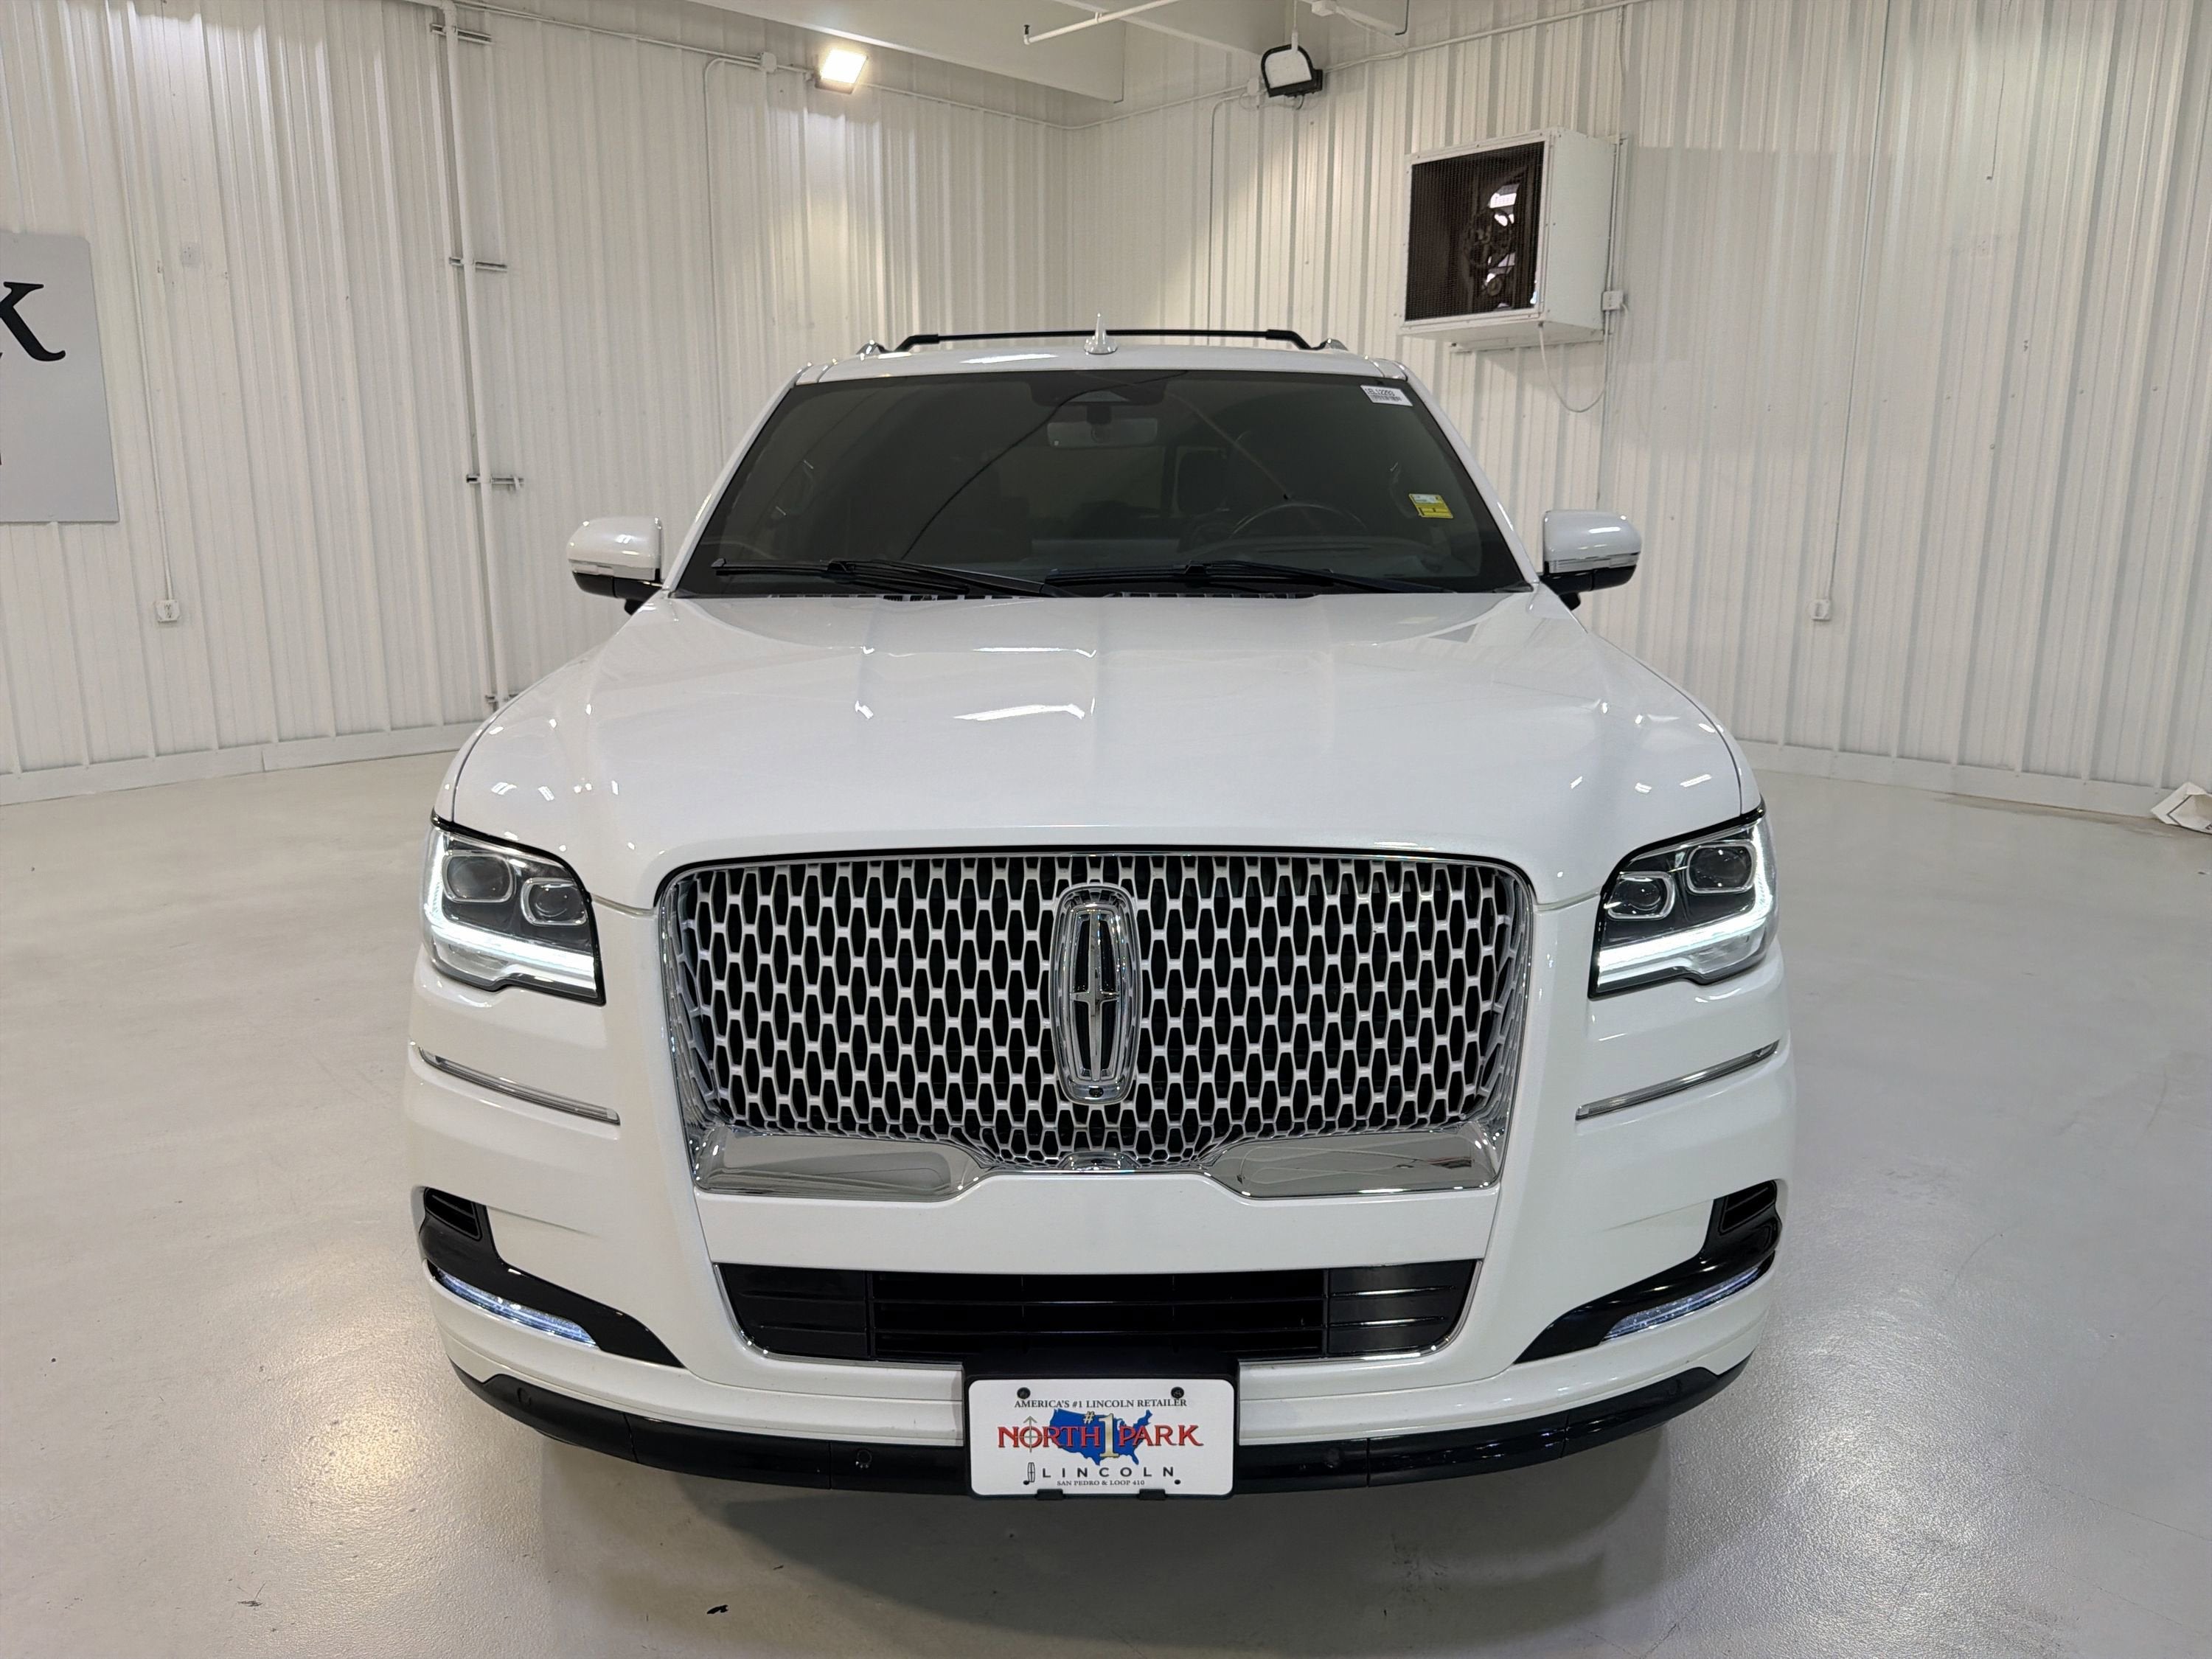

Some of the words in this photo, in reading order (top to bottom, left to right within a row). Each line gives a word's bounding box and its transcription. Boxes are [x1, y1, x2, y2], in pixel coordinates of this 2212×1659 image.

[1014, 1399, 1070, 1408] AMERICA'S
[1071, 1399, 1083, 1408] #1
[1086, 1399, 1135, 1408] LINCOLN
[1137, 1399, 1188, 1408] RETAILER
[998, 1426, 1101, 1448] NORTH
[1118, 1425, 1205, 1447] PARK
[1042, 1466, 1174, 1478] LINCOLN
